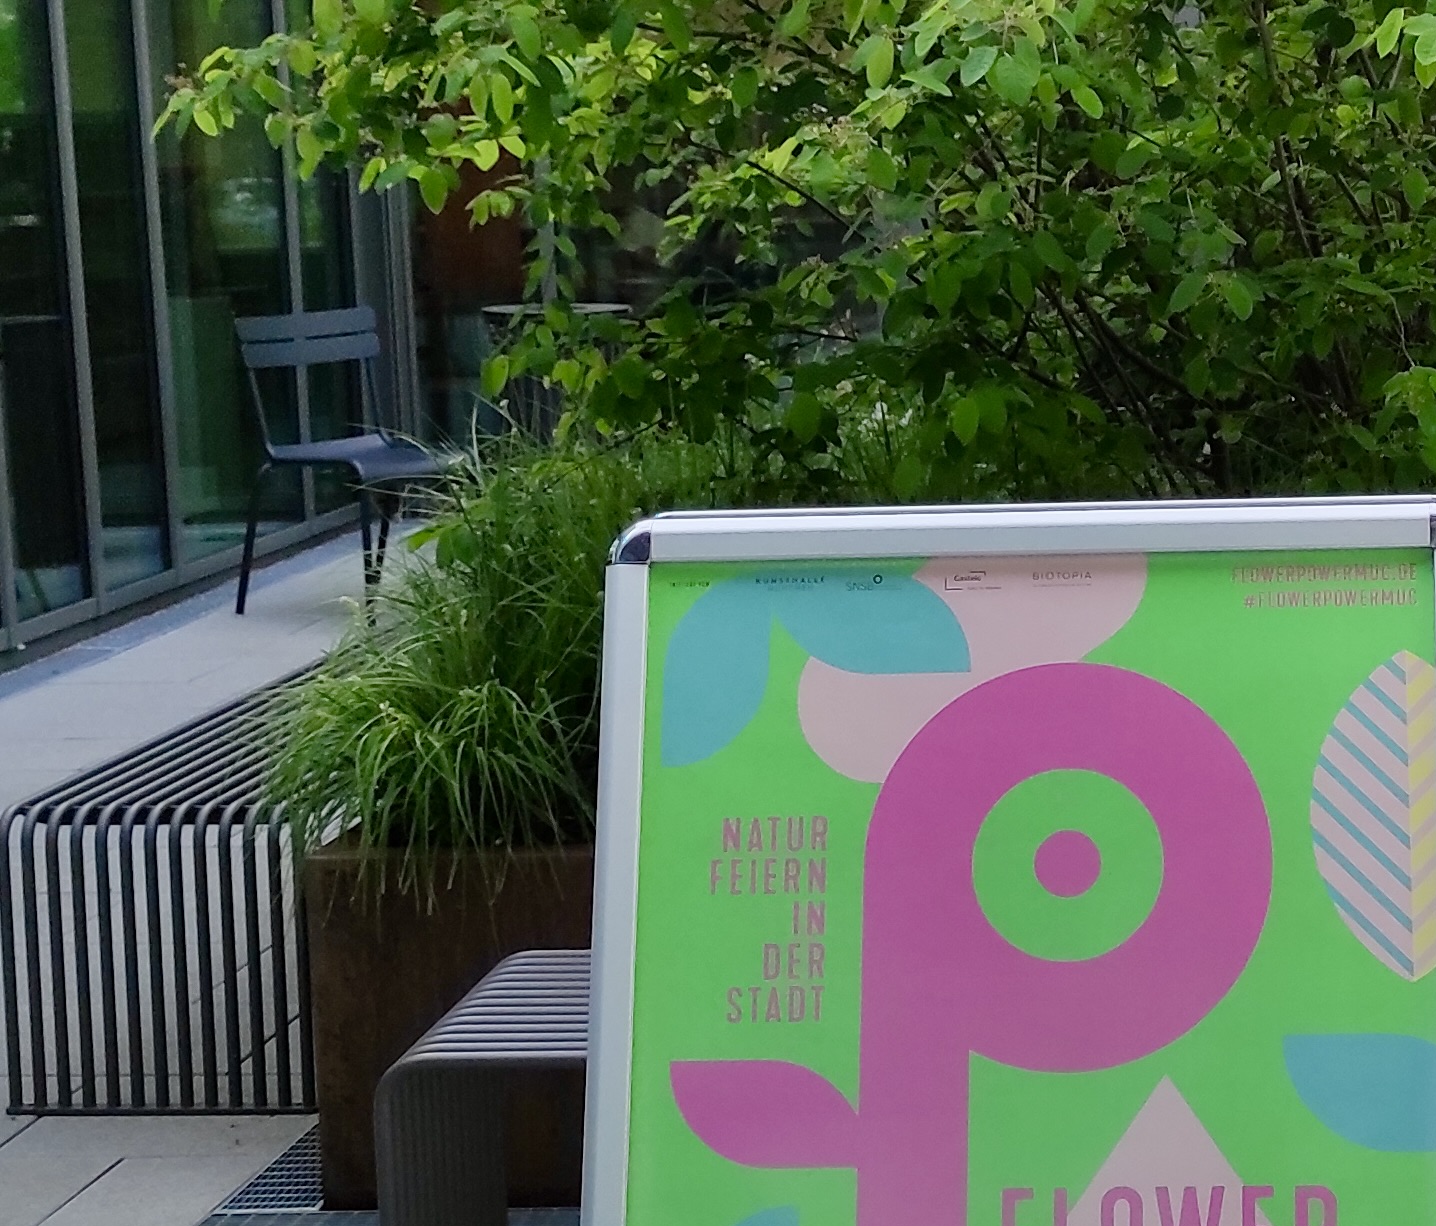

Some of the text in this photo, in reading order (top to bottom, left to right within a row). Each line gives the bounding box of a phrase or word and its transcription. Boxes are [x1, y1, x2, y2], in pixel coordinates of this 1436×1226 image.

[1032, 571, 1092, 581] BIOTOPIA
[1232, 563, 1417, 583] FLOWERPOWERMUC.DE
[1244, 588, 1417, 608] #FLOWERPOWERMUC
[722, 816, 828, 852] NATUR
[710, 857, 826, 895] FEIERN
[793, 900, 825, 936] IN
[763, 943, 825, 980] DER
[726, 985, 825, 1024] STADT
